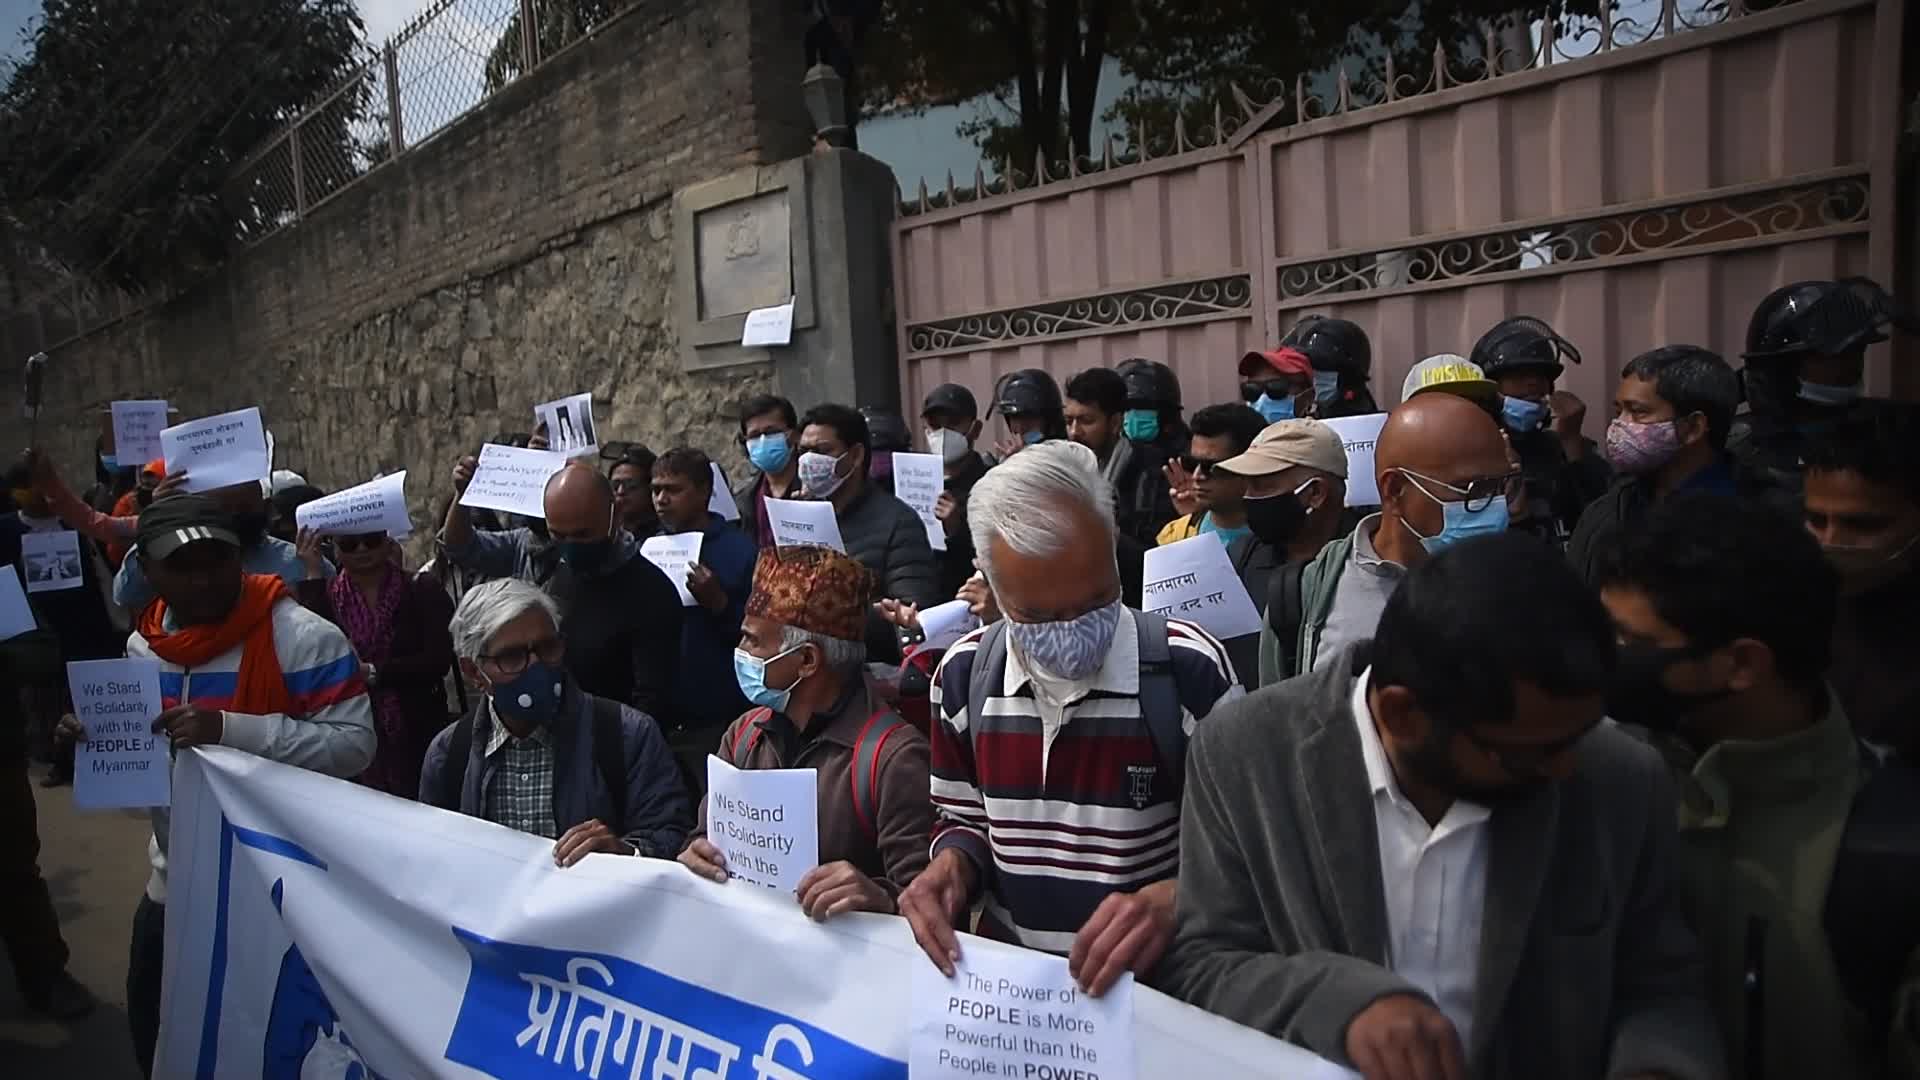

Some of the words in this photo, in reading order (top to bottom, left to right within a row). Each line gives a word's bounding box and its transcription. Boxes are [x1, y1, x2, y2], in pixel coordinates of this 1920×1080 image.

[350, 500, 384, 513] POWER
[82, 683, 103, 697] We
[107, 680, 141, 695] Stand
[80, 705, 91, 715] in
[95, 701, 149, 715] Solidarity
[96, 721, 120, 735] with
[123, 719, 143, 731] the
[86, 738, 141, 753] PEOPLE
[144, 739, 154, 751] of
[92, 759, 151, 775] Myanmar
[715, 791, 735, 813] We
[738, 799, 784, 823] Stand
[713, 815, 725, 833] in
[728, 820, 794, 855] Solidarity
[728, 848, 752, 870] with
[755, 856, 778, 876] the
[967, 971, 993, 993] The
[998, 978, 1053, 1002] Power
[1059, 986, 1077, 1004] of
[948, 997, 1021, 1026] PEOPLE
[1027, 1010, 1042, 1029] is
[1048, 1013, 1095, 1034] More
[945, 1023, 1017, 1051] Powerful
[1023, 1038, 1063, 1057] than
[1070, 1042, 1097, 1063] the
[939, 1049, 997, 1075] People
[1003, 1060, 1018, 1077] in
